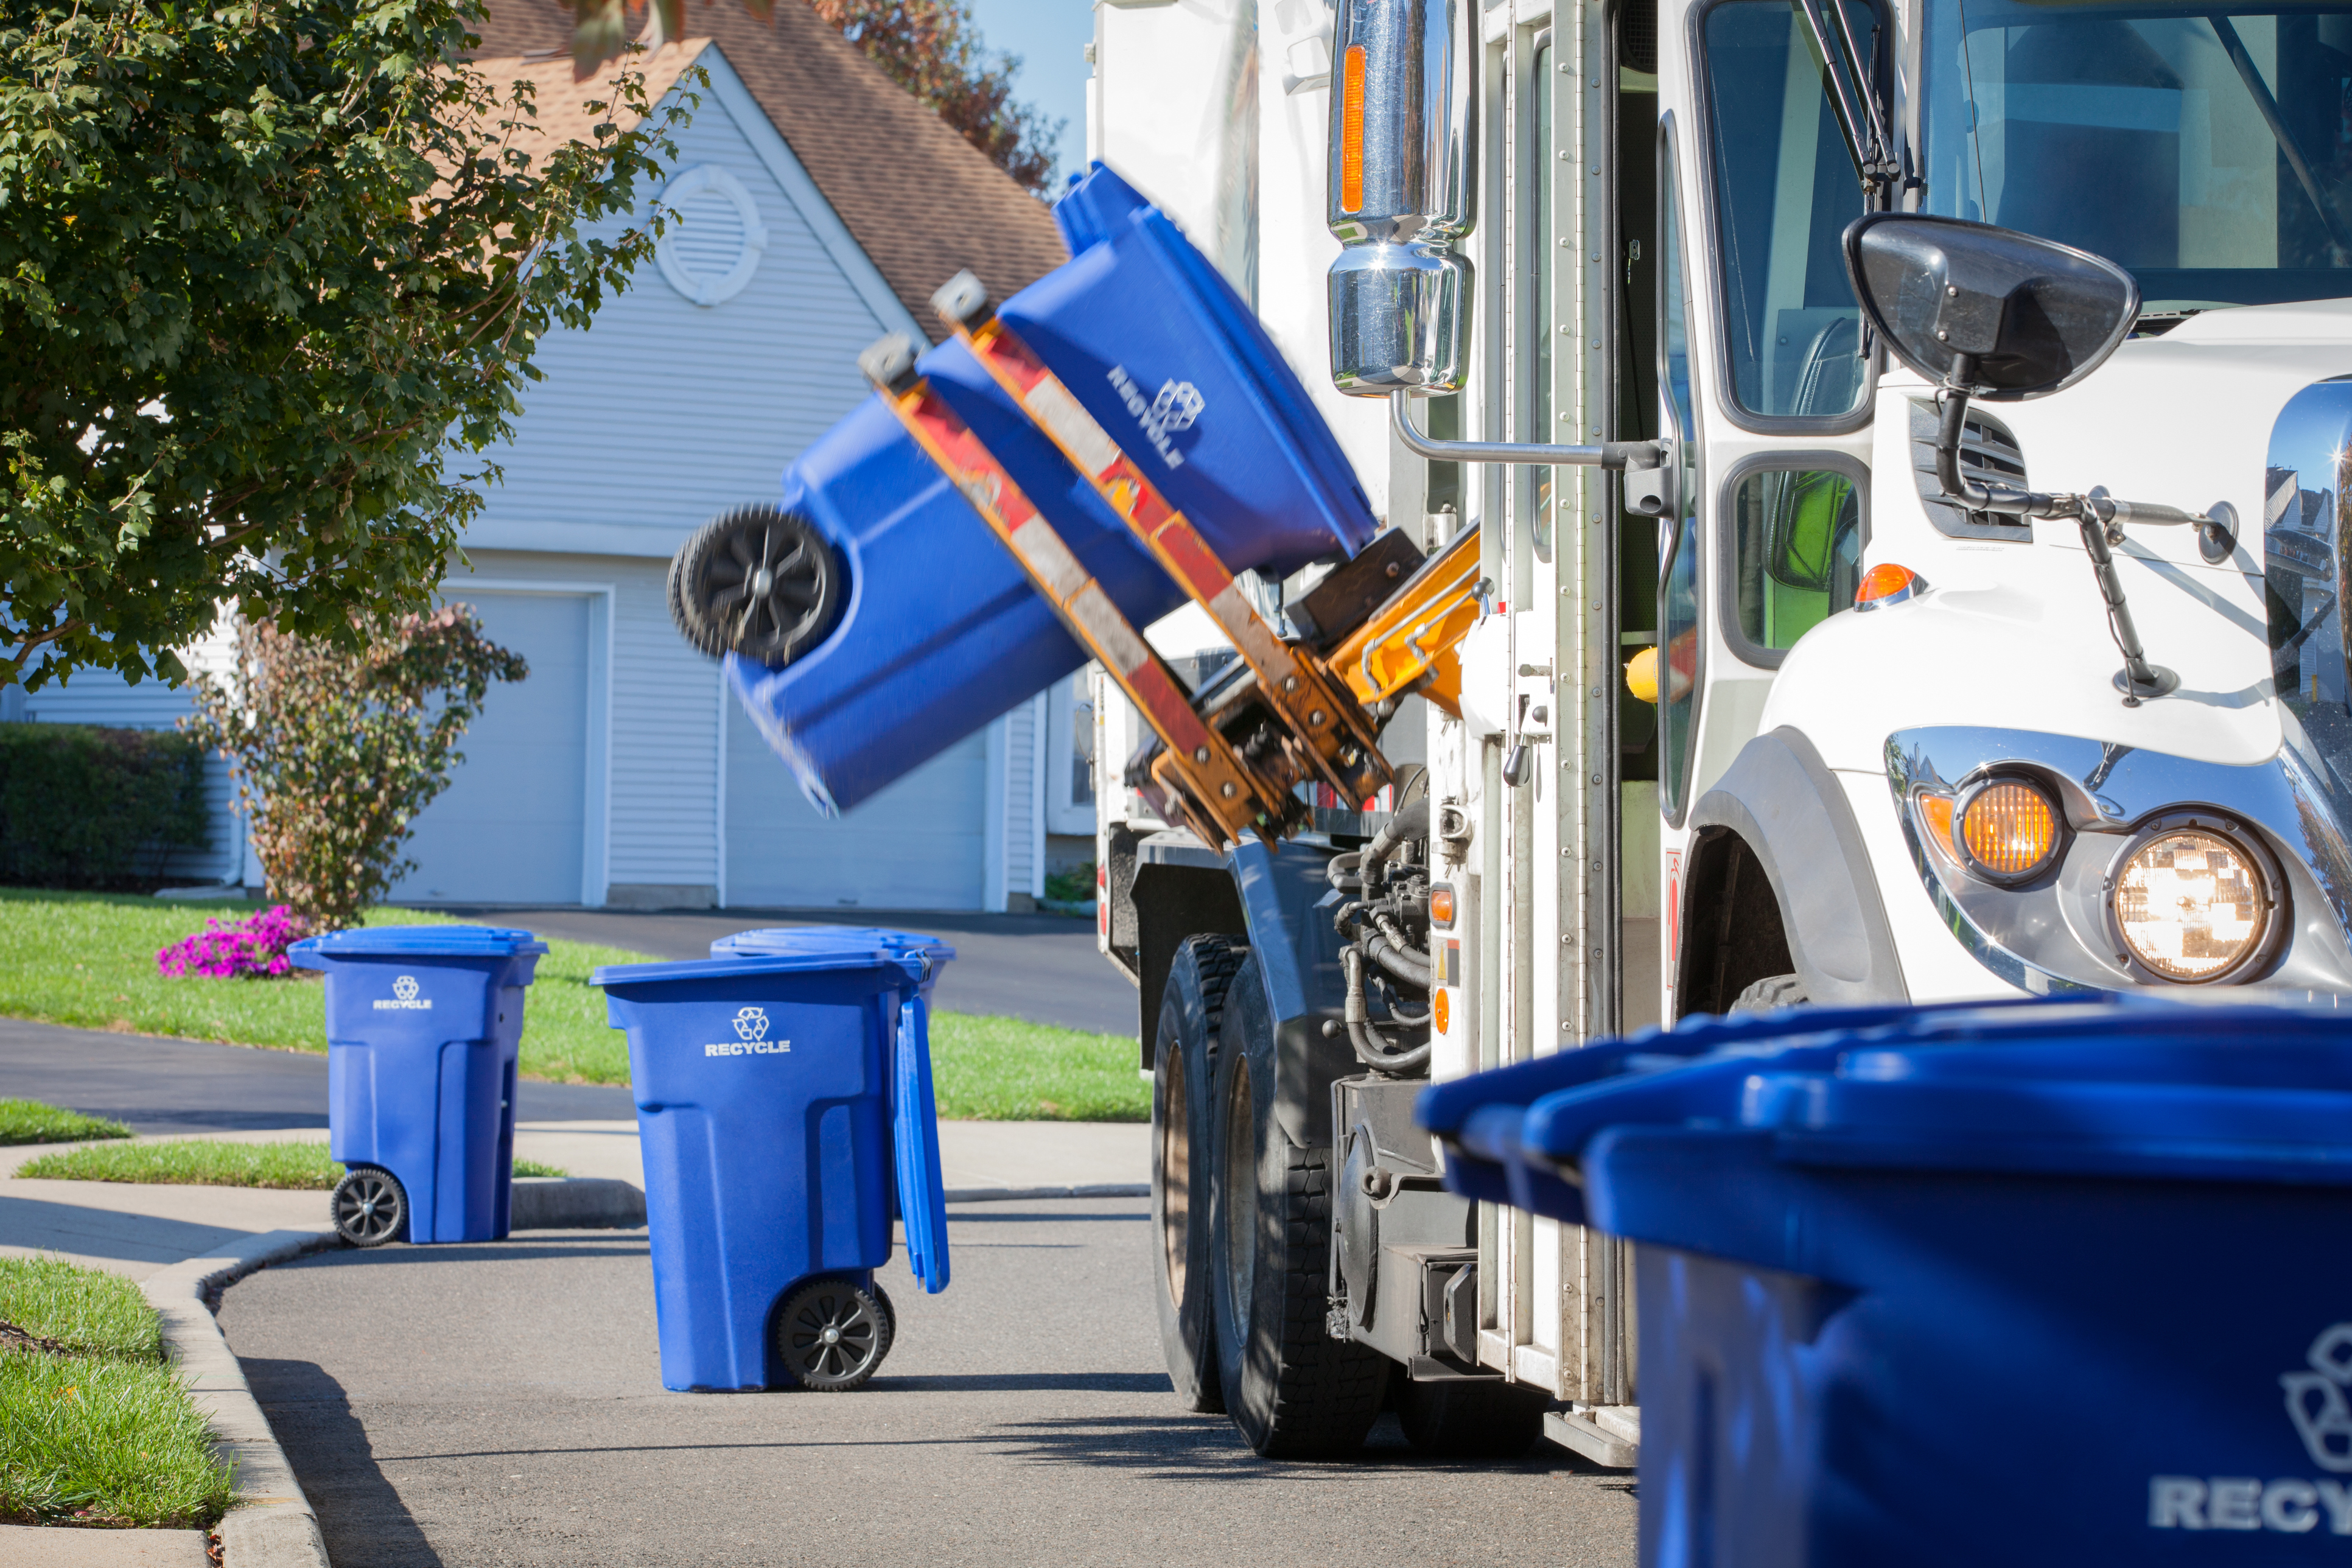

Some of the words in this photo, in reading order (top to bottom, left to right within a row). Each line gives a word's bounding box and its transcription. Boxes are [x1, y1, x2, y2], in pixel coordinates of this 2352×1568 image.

[1107, 365, 1185, 470] RECYCLE
[373, 999, 432, 1009] RECYCLE
[705, 1040, 791, 1057] RECYCLE
[2148, 1475, 2352, 1535] RECY
